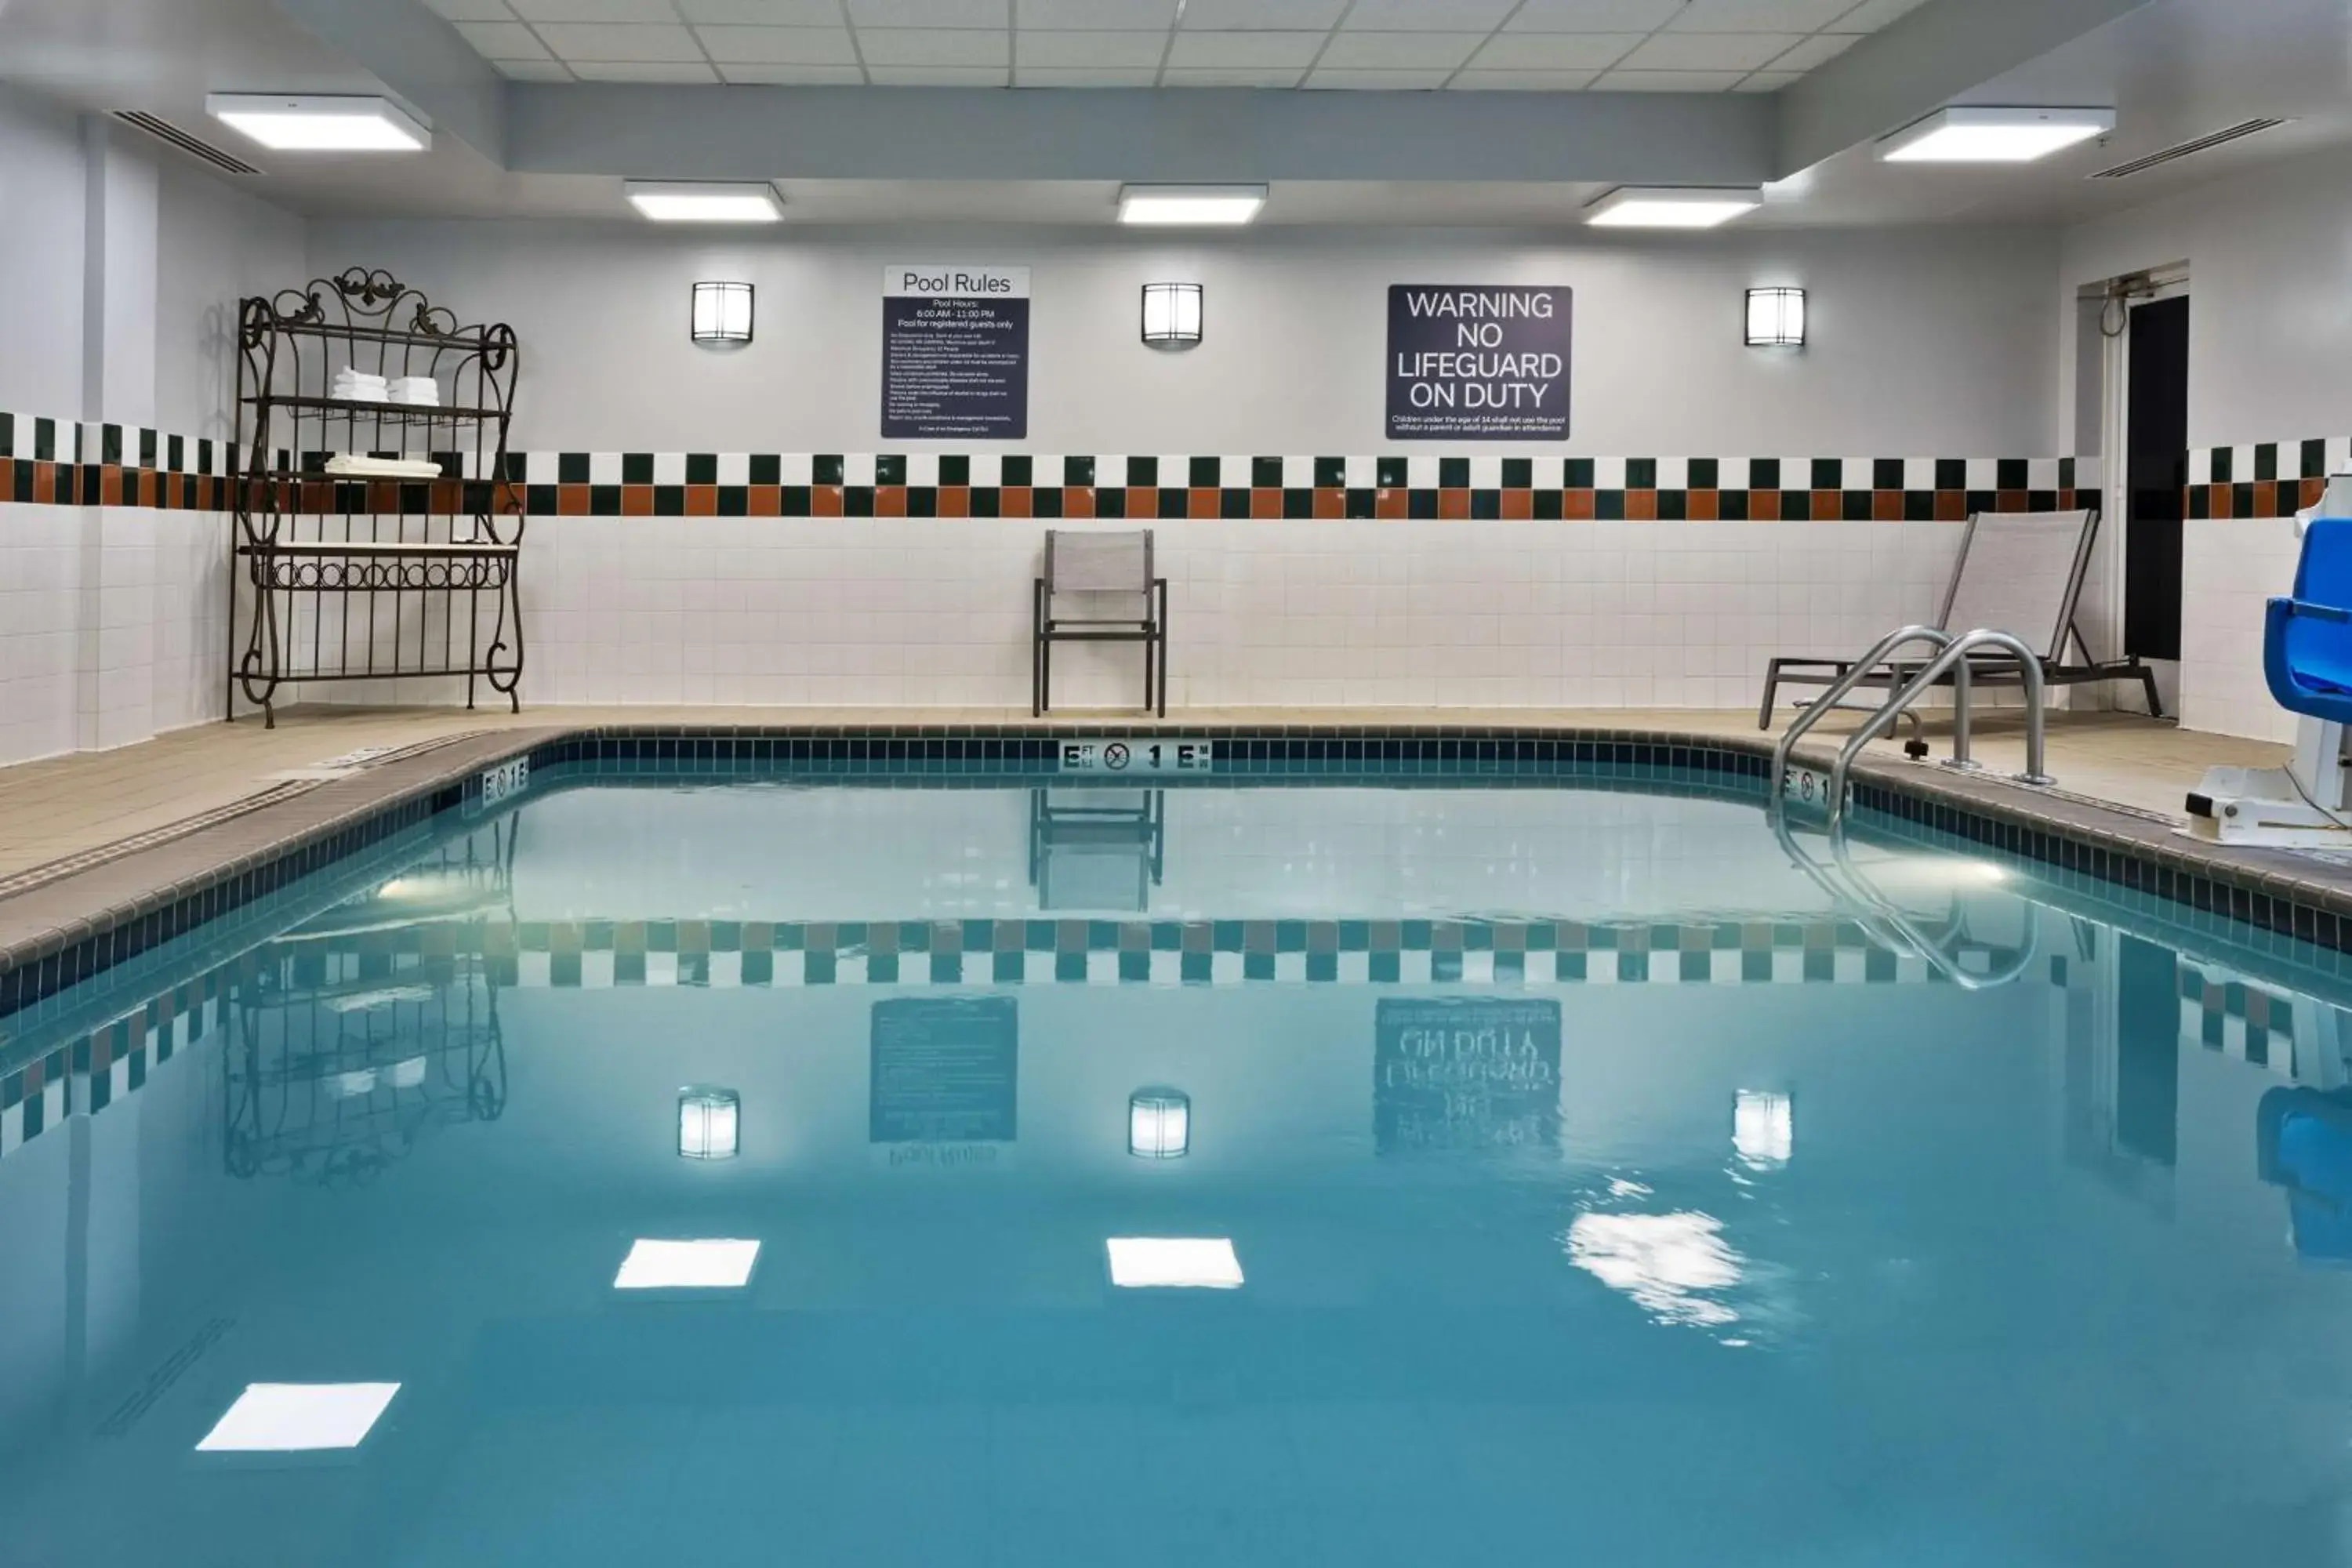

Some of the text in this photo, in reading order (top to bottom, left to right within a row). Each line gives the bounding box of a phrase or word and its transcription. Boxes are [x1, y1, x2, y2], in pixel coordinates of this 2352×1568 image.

[903, 272, 1011, 292] Pool Rules
[1406, 292, 1554, 318] WARNING
[898, 319, 1014, 331] Pool for registered guests only
[1457, 323, 1504, 347] NO
[1398, 352, 1563, 378] LIFEGUARD
[1410, 383, 1549, 408] ON DUTY
[1429, 424, 1453, 433] parent
[1457, 416, 1472, 425] age
[1549, 416, 1566, 425] pool
